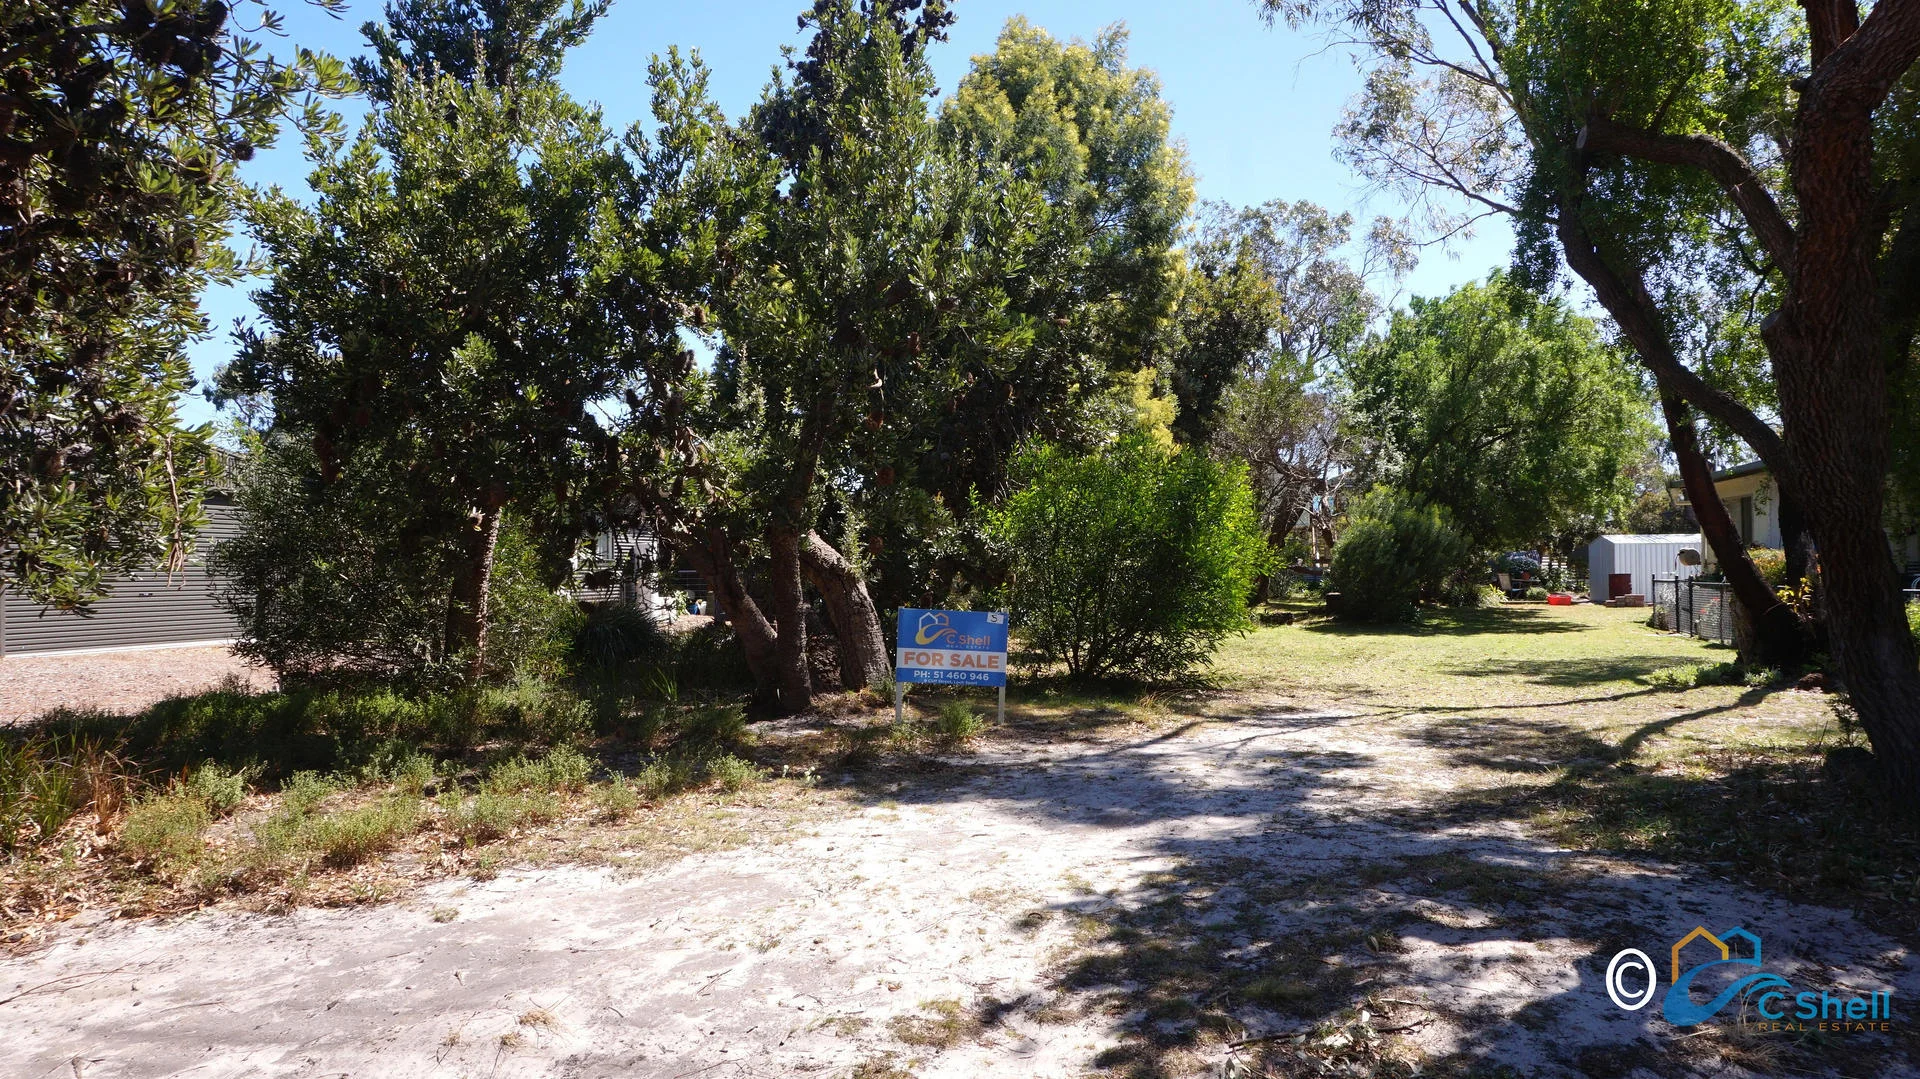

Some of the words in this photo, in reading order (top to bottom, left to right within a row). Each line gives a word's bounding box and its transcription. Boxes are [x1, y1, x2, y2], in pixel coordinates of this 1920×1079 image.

[946, 634, 955, 645] C
[960, 635, 991, 646] Shell
[903, 651, 944, 667] FOR
[950, 653, 1000, 669] SALE
[913, 670, 931, 679] PH:
[933, 671, 944, 679] 51
[946, 671, 967, 680] 460
[969, 672, 990, 681] 946
